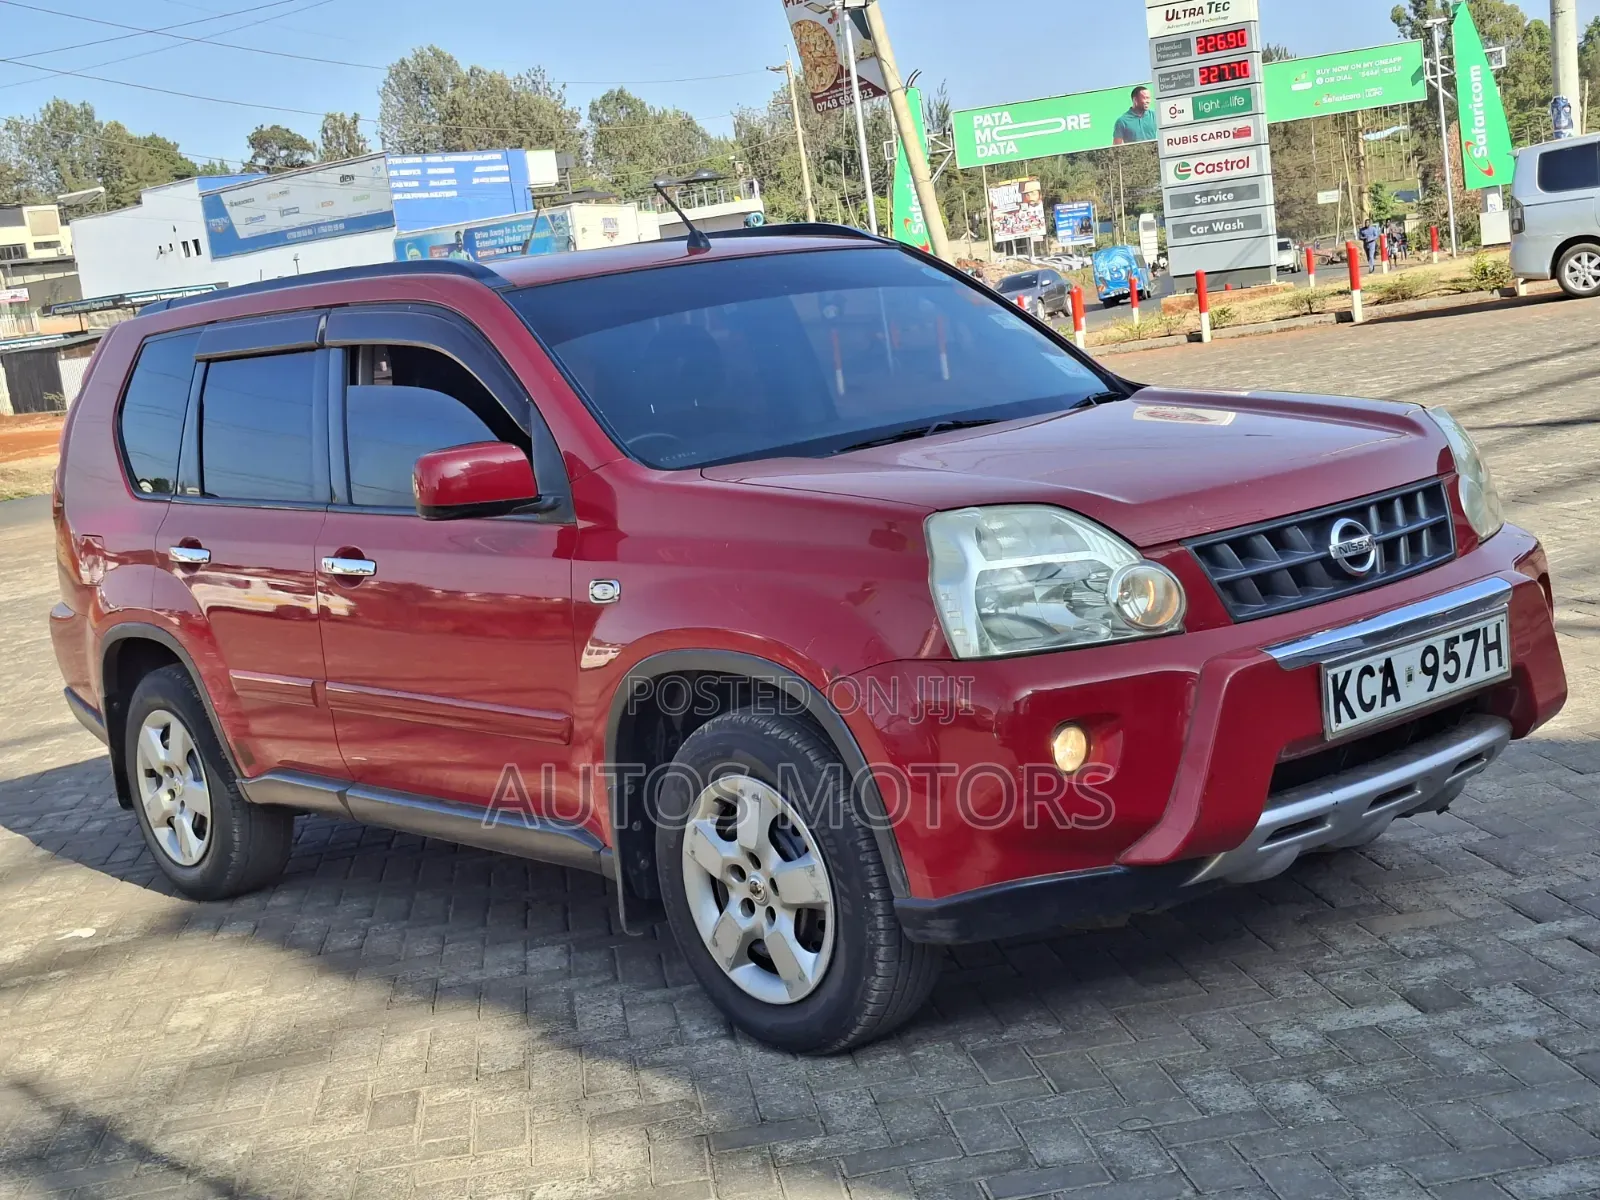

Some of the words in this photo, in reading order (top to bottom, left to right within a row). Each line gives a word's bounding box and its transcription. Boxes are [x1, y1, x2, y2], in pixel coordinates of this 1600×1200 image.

[1165, 6, 1204, 22] ULTRA
[1207, 1, 1230, 14] TEC
[1196, 30, 1247, 53] 226.90
[1199, 61, 1250, 84] 227.70
[1316, 68, 1331, 76] BUY
[1332, 65, 1349, 73] NOW
[816, 98, 838, 112] 0748
[859, 88, 874, 100] 23
[1198, 98, 1221, 113] light
[1229, 95, 1245, 108] life
[972, 111, 1014, 129] PATA
[1468, 65, 1488, 159] Safaricom
[974, 113, 1092, 144] MORE
[1166, 134, 1198, 147] RUBIS
[1200, 130, 1231, 142] CARD
[976, 141, 1019, 158] DATA
[1194, 156, 1250, 175] Castrol
[1194, 191, 1234, 205] Service
[1190, 224, 1209, 235] Car
[1212, 219, 1244, 232] Wash
[1331, 657, 1401, 724] KCA
[1420, 623, 1503, 693] 957H
